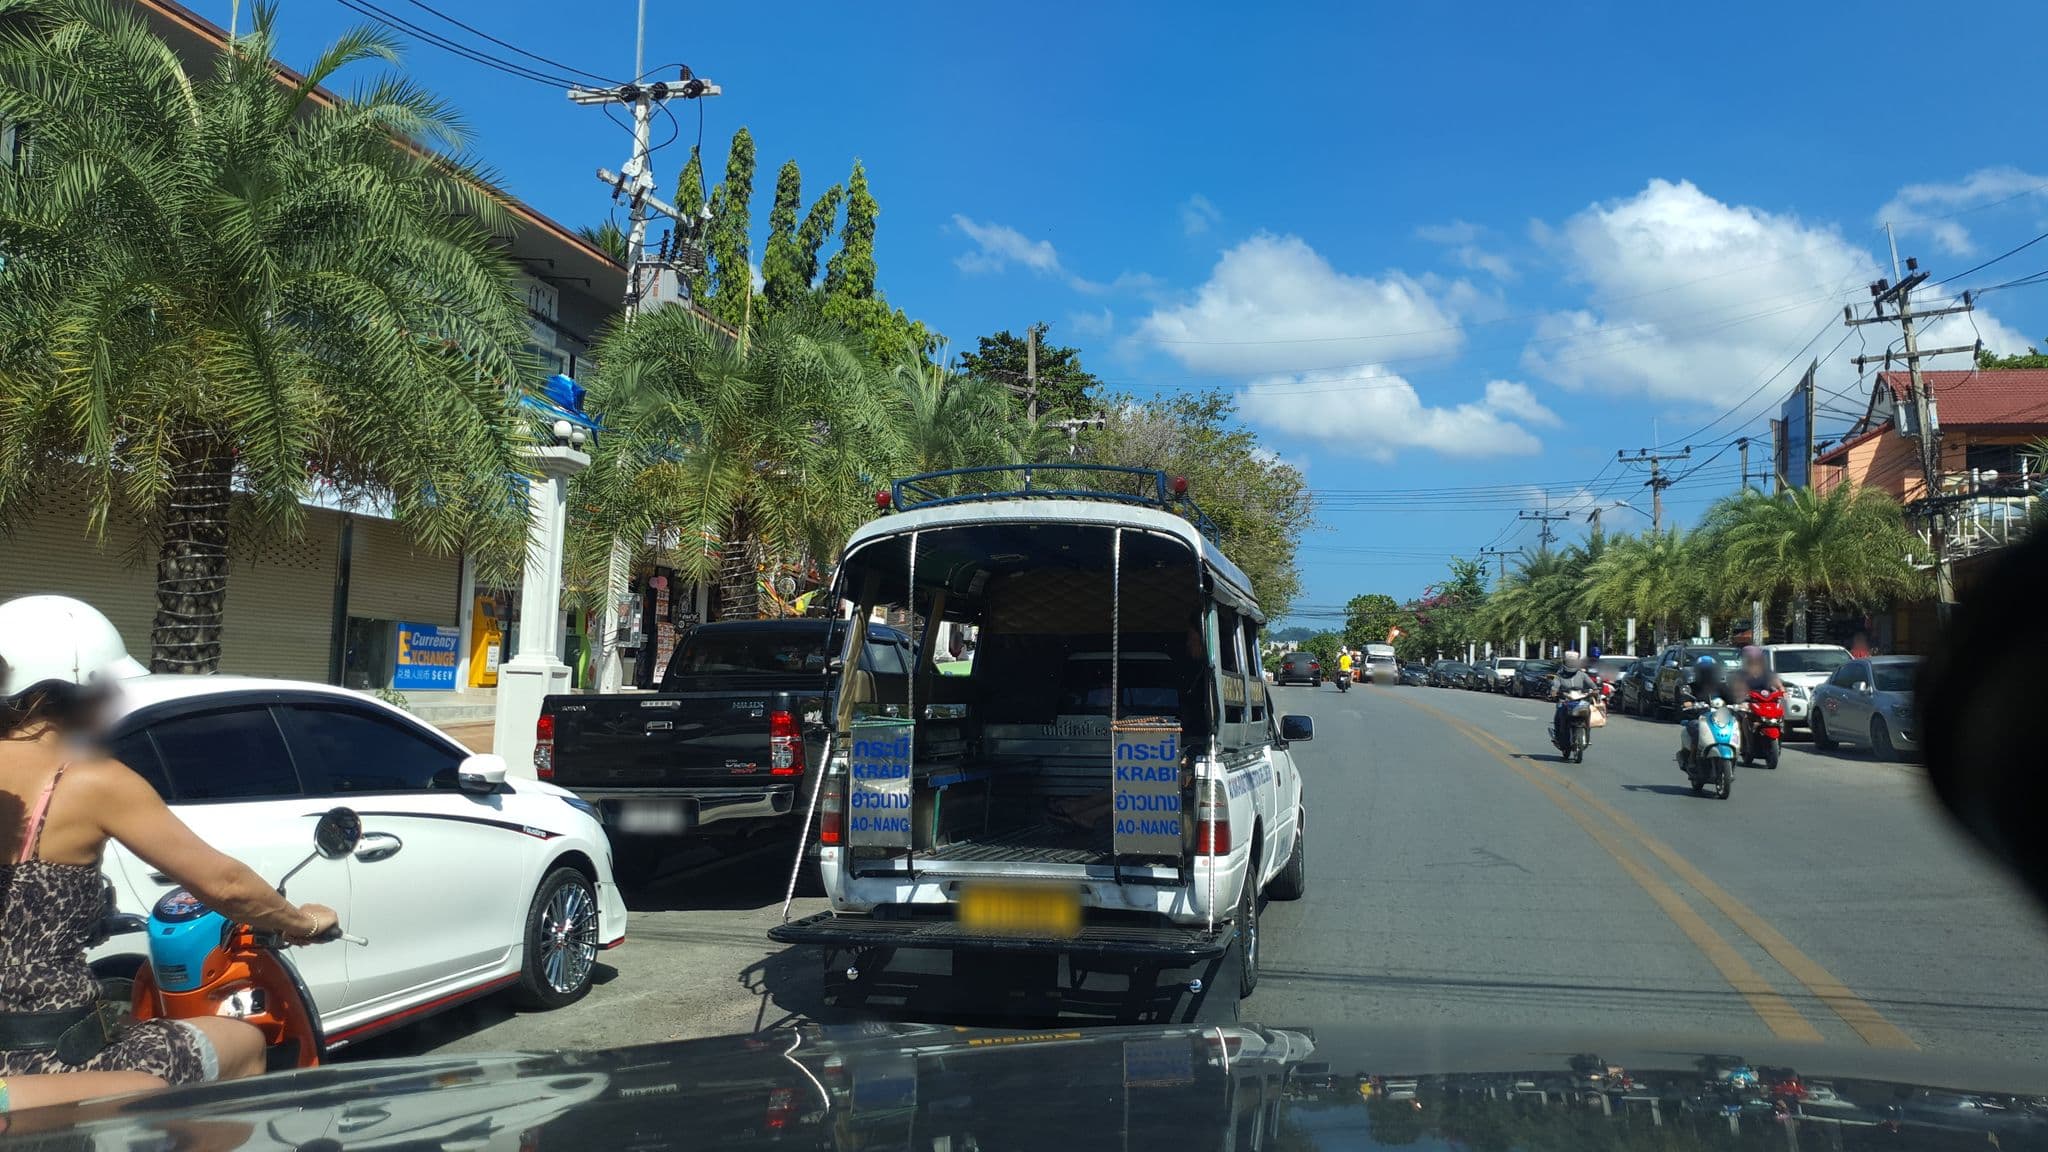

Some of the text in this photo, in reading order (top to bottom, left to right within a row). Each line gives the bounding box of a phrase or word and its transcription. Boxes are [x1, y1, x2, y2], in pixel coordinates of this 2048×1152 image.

[412, 632, 456, 650] Currency
[1117, 734, 1175, 761] กระบี่
[854, 764, 909, 778] KRABI
[1117, 766, 1177, 782] KRABI
[851, 788, 909, 808] อ่าวนาง
[1116, 790, 1178, 811] อ่าวนาง
[851, 816, 909, 832] AO-NANG
[1116, 819, 1179, 835] AO-NANG
